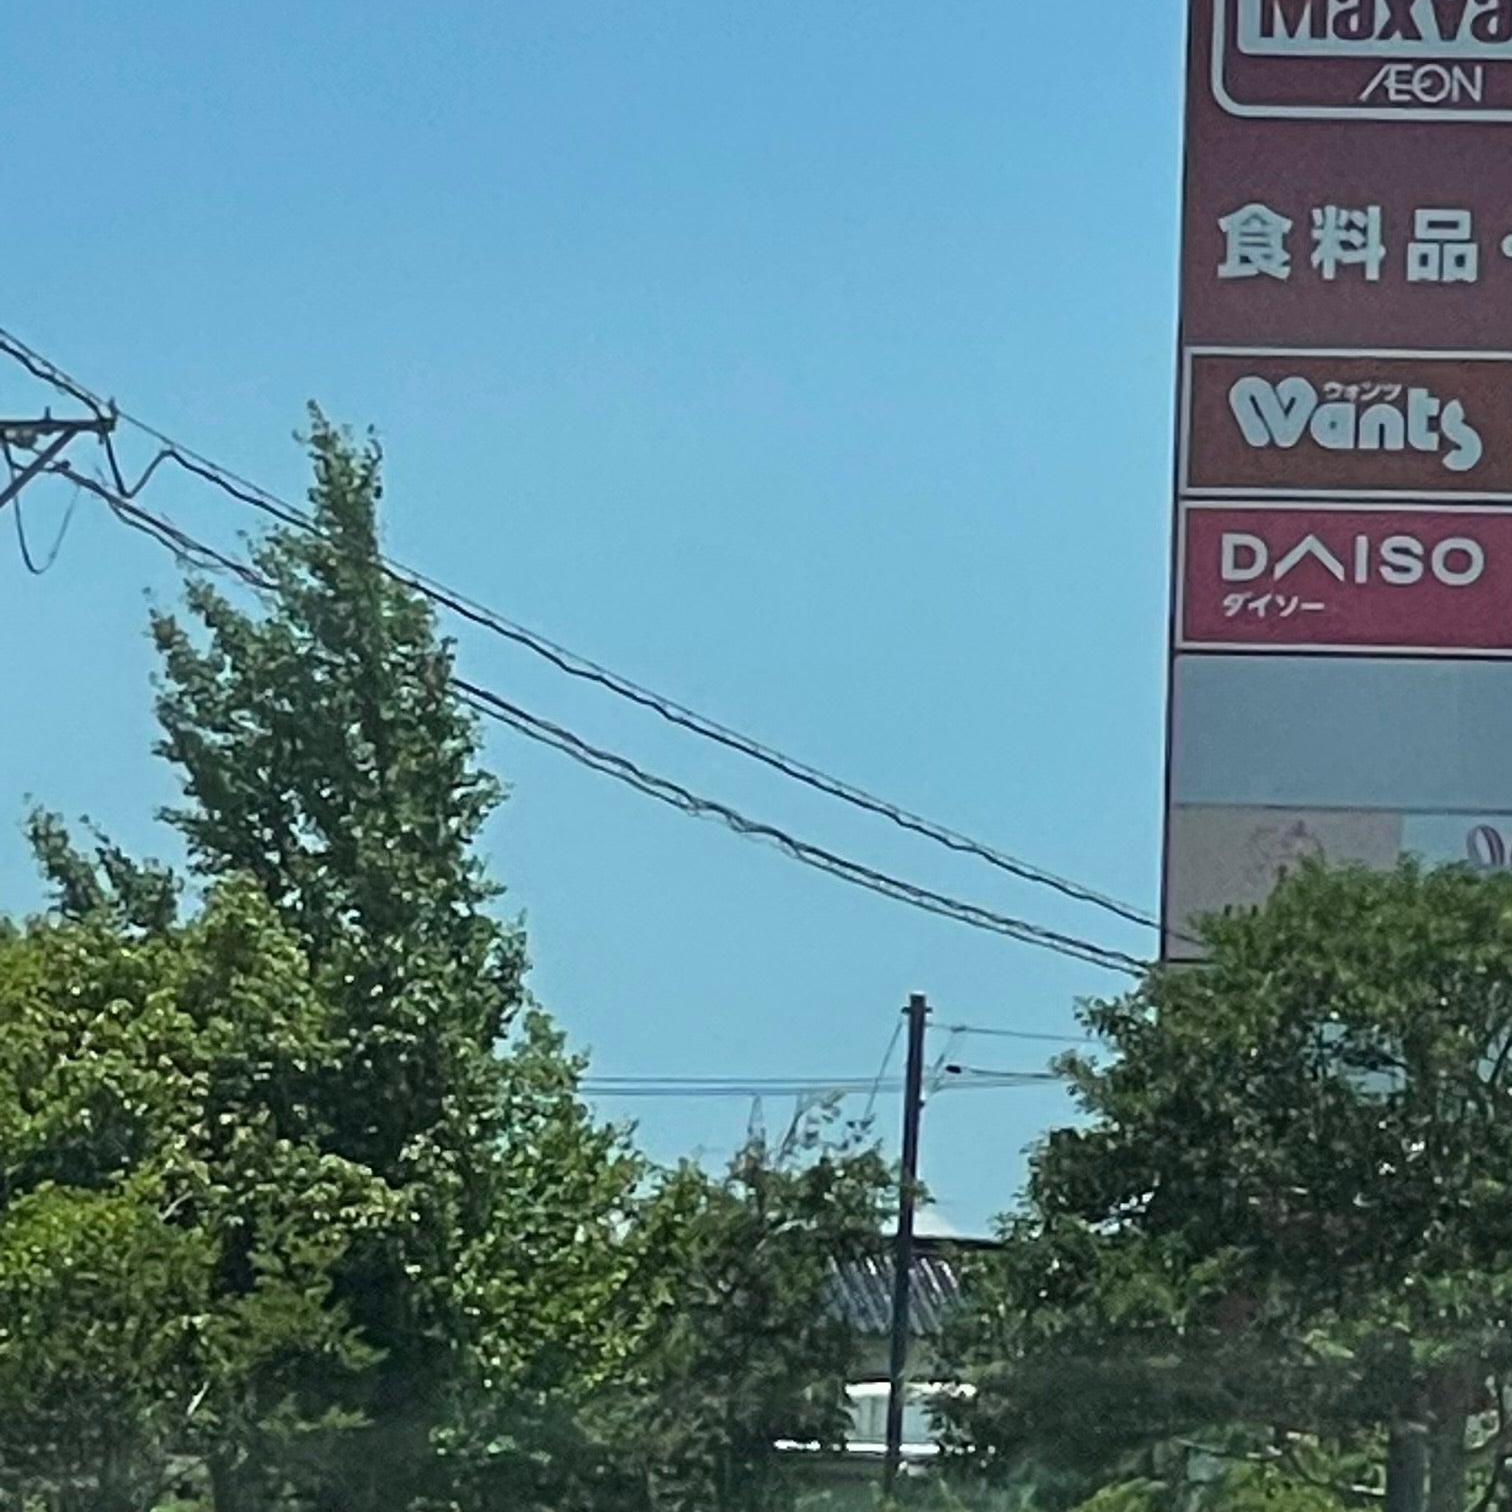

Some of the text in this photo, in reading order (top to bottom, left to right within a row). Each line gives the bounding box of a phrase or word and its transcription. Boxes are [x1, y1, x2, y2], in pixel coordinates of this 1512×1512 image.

[1323, 382, 1402, 402] ウォンツ
[1229, 376, 1482, 471] Wants
[1221, 533, 1485, 586] DAISO
[1222, 594, 1325, 619] ダイソー
